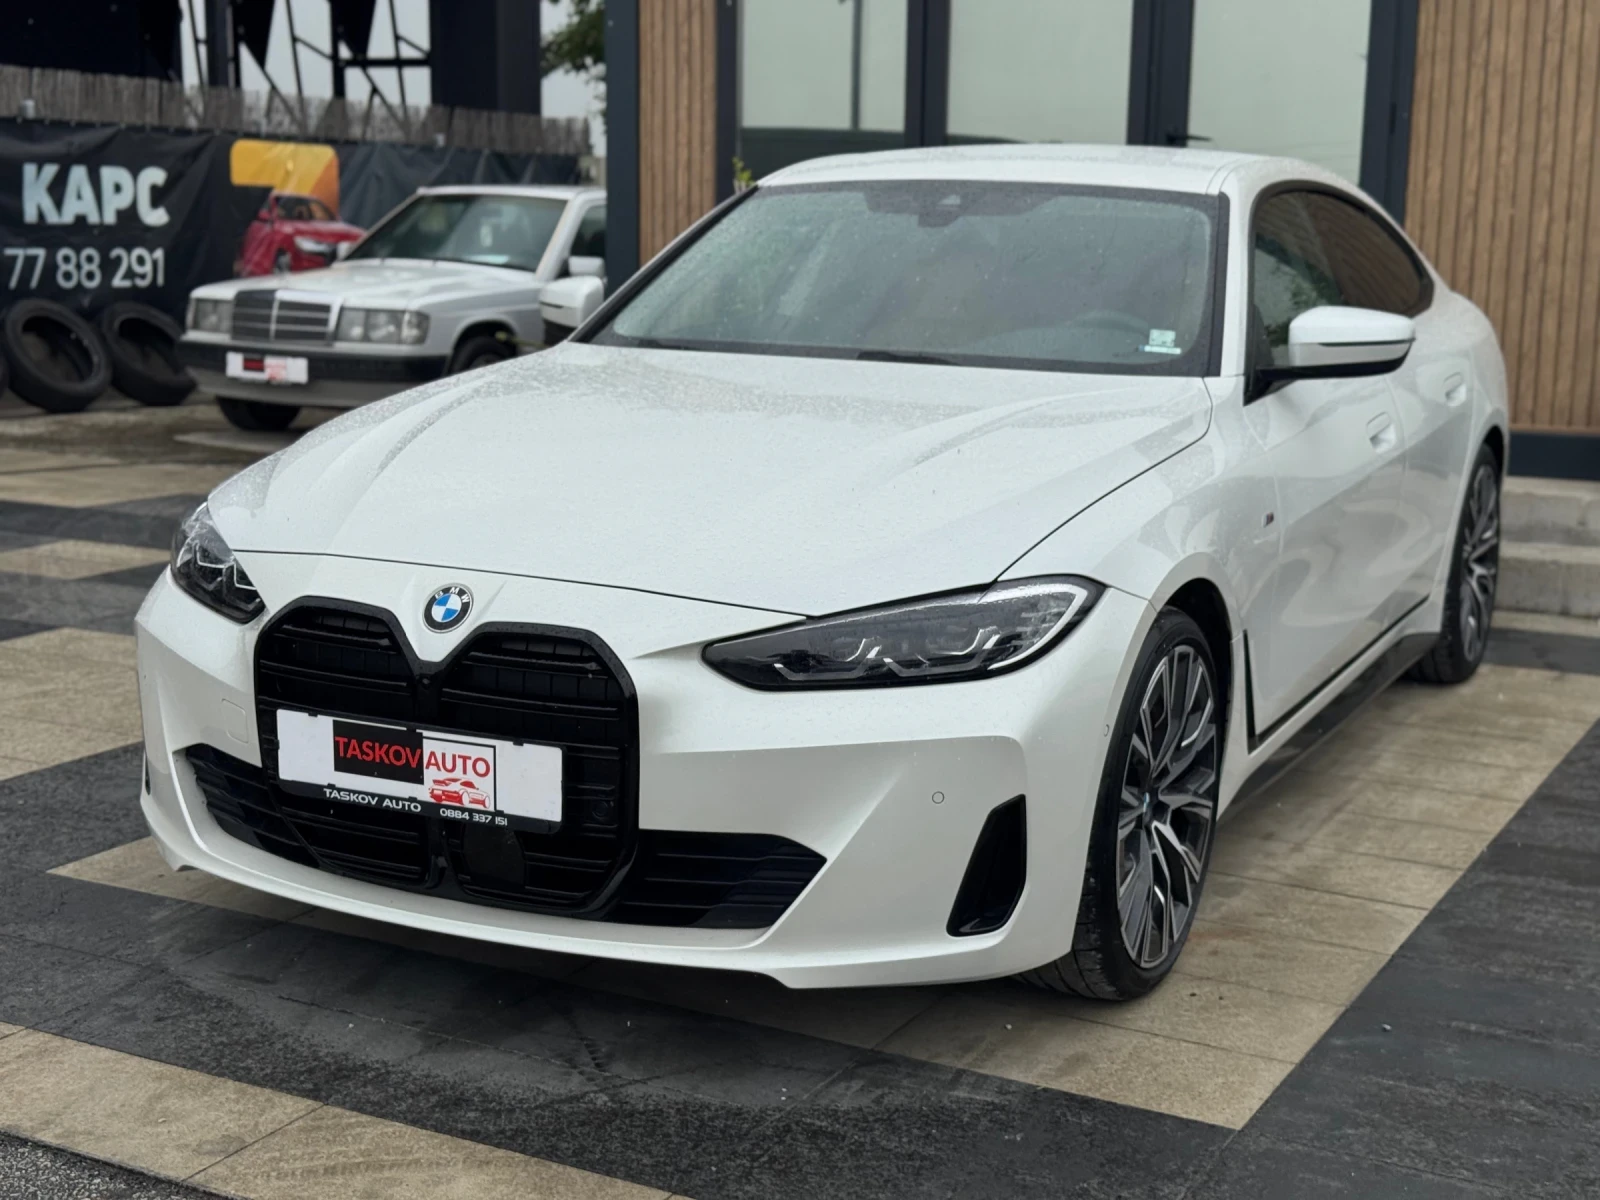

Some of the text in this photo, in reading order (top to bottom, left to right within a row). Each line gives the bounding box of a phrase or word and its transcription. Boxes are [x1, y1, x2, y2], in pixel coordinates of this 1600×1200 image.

[3, 246, 165, 290] 77 88 291
[434, 586, 470, 604] BMW
[334, 736, 491, 778] TASKOV AUTO
[323, 788, 422, 813] TASKOV AUTO
[440, 808, 469, 820] 0884
[472, 812, 492, 823] 337
